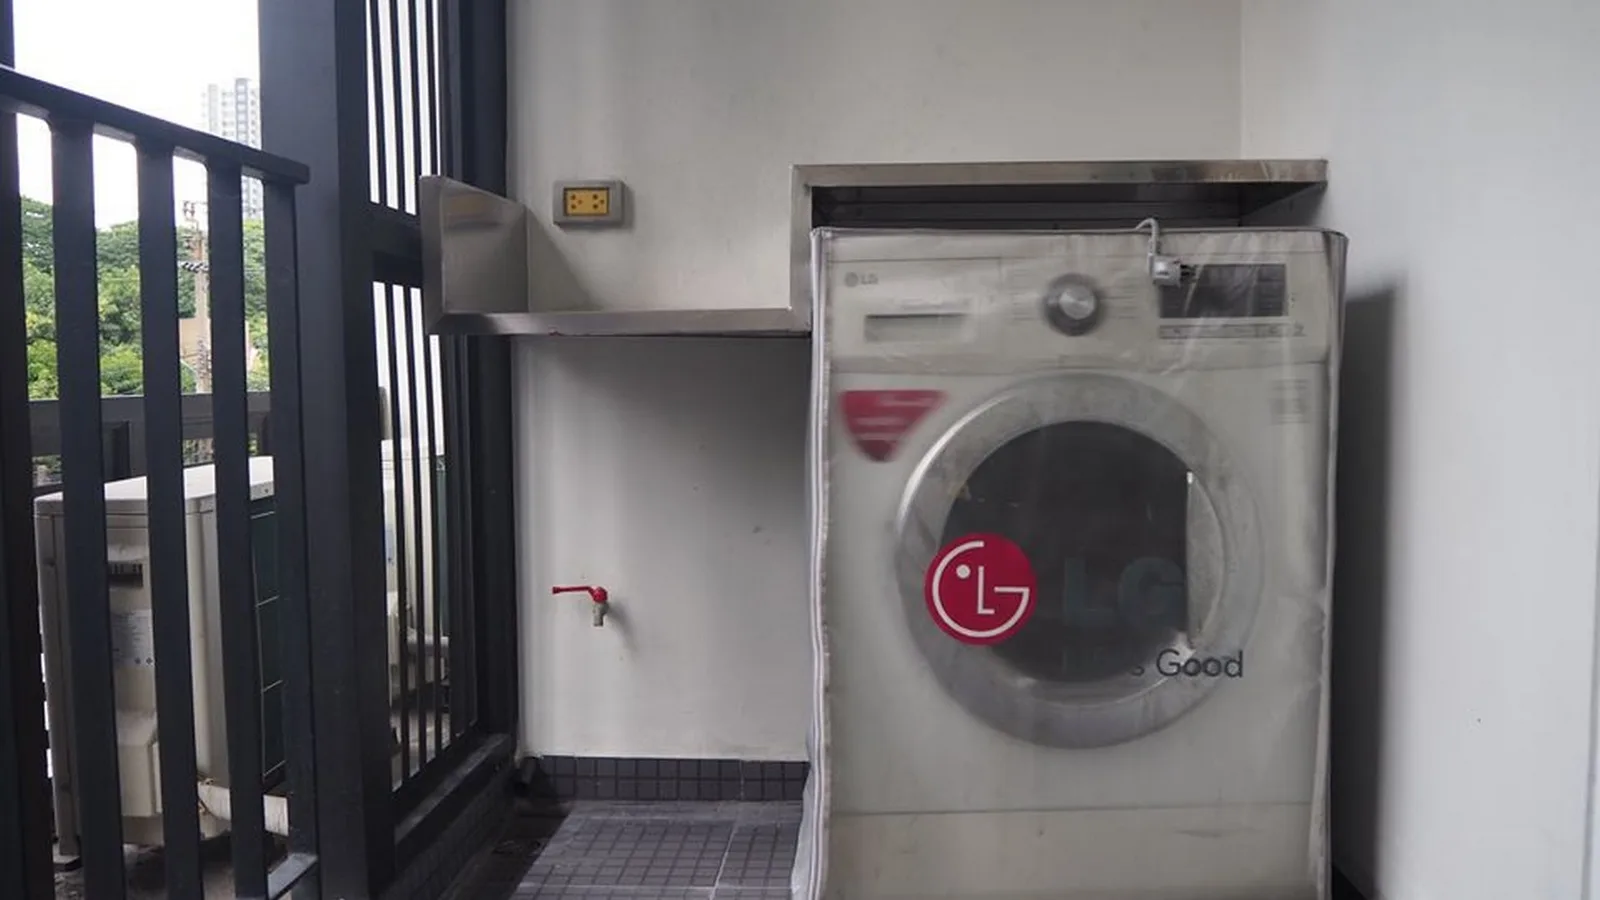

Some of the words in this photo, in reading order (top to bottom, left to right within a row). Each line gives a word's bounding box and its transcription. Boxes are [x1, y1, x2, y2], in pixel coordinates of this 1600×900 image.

[860, 273, 879, 285] LG
[1063, 556, 1186, 632] LG
[1156, 649, 1244, 678] Good
